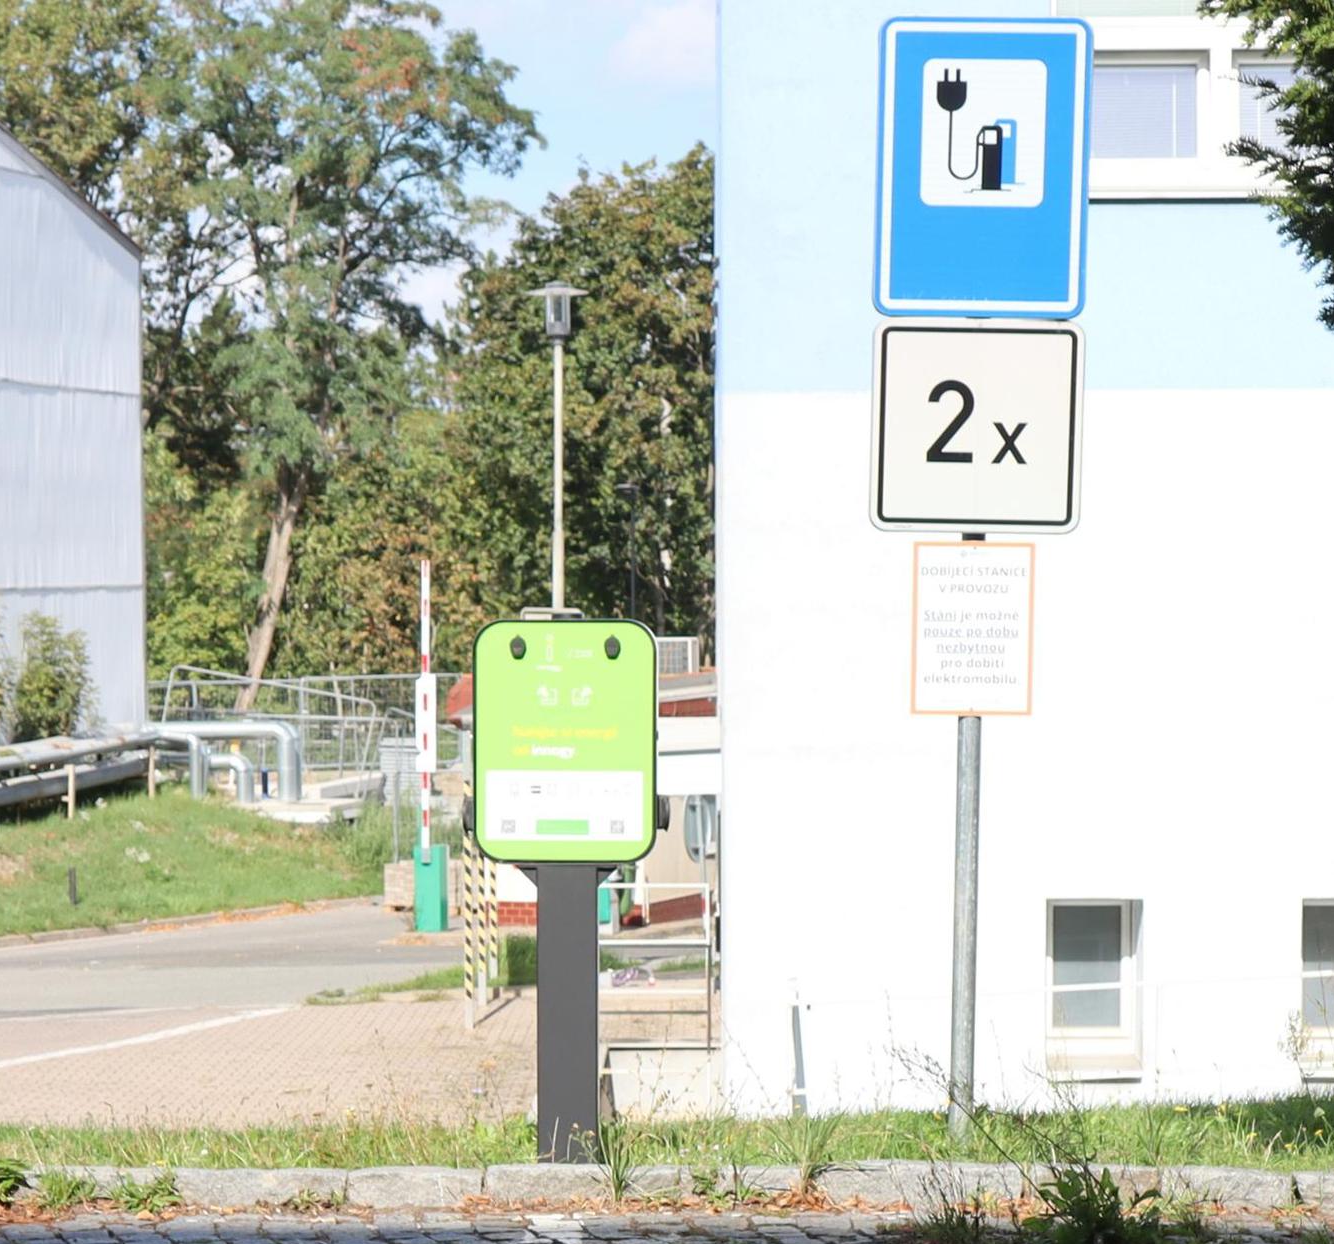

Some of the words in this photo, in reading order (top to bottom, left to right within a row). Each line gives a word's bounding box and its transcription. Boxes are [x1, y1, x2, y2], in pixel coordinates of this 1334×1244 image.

[926, 379, 974, 463] 2
[991, 422, 1028, 464] x
[978, 567, 1028, 577] STANICE
[939, 584, 946, 593] V
[950, 584, 1009, 594] PROVOZU
[960, 609, 972, 623] je
[923, 627, 963, 640] pouze
[966, 627, 982, 640] po
[985, 625, 1019, 639] dobu
[936, 642, 1006, 655] nezbytnou
[940, 660, 963, 670] pro
